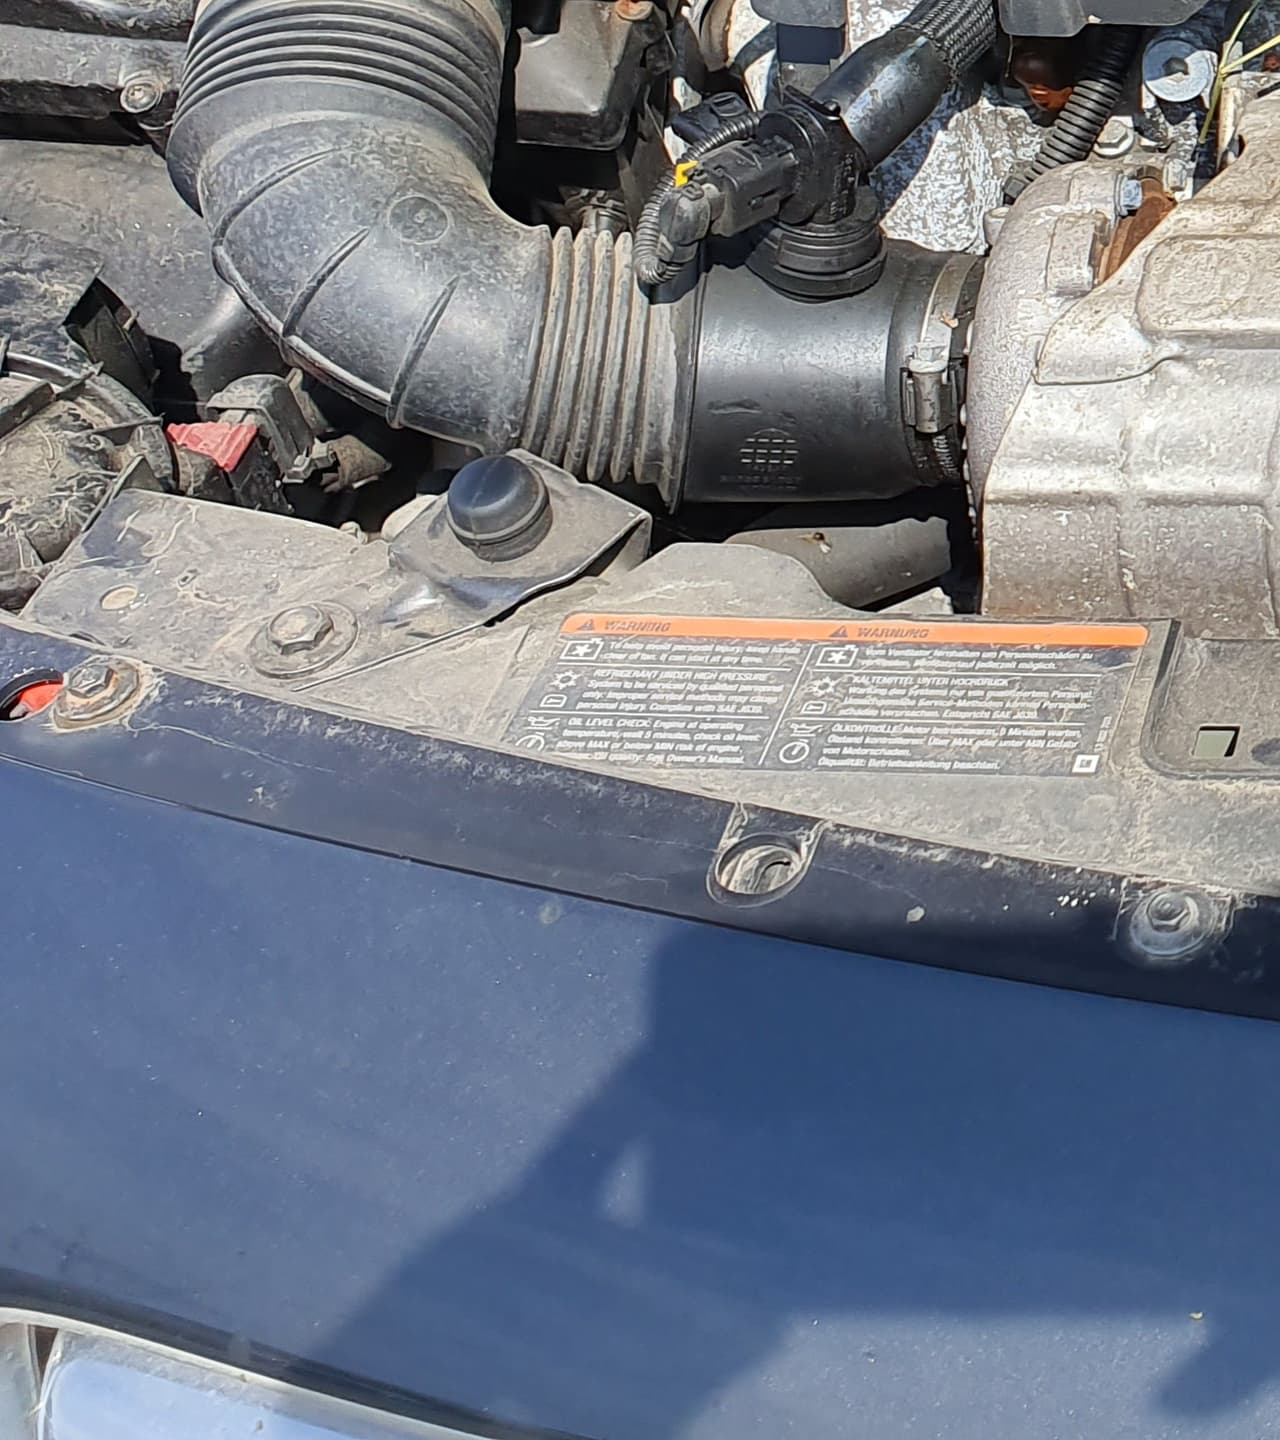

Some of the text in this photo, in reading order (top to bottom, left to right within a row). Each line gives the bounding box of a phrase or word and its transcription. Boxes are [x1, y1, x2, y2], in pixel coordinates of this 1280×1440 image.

[604, 620, 671, 633] WARNING
[858, 627, 929, 639] WARNUNG
[592, 669, 769, 681] REFRIGERANT UNDER HIGH PRESSURE
[585, 680, 622, 688] System
[715, 705, 737, 713] SAE
[566, 717, 584, 725] OIL
[584, 718, 615, 726] LEVEL
[653, 720, 686, 728] Engine
[686, 720, 698, 728] at
[697, 721, 745, 730] operating
[586, 740, 610, 748] MAX
[950, 736, 976, 746] MAX
[1024, 738, 1045, 747] MIN
